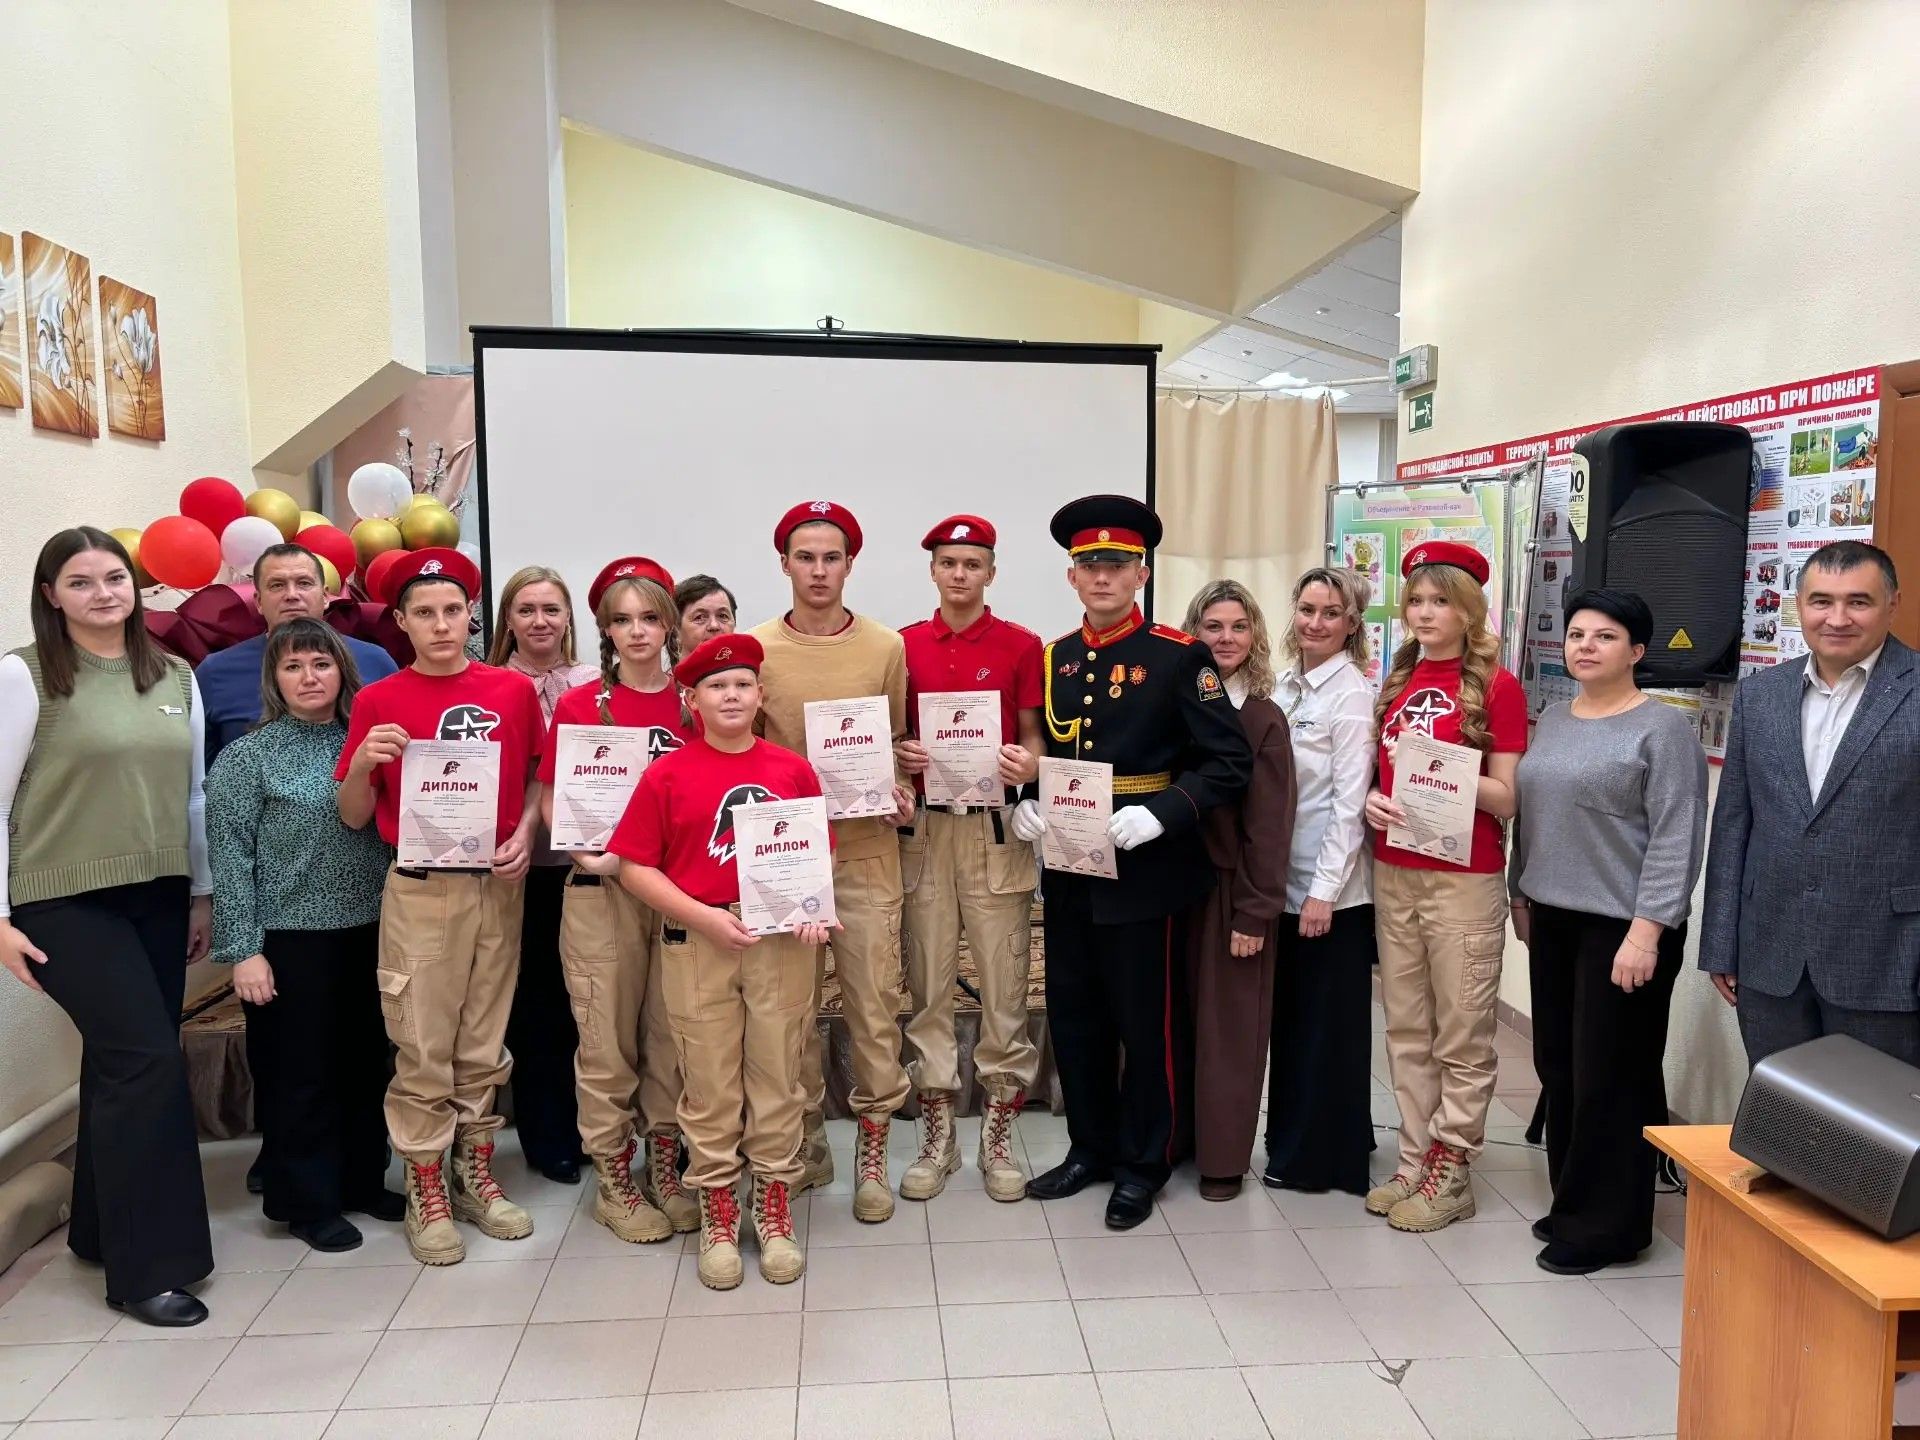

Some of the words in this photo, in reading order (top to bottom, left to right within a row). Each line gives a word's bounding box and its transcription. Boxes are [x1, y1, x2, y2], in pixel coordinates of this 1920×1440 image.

[1687, 396, 1776, 421] ДЕЙСТВОВАТЬ
[1779, 387, 1809, 410] ПРИ
[1811, 374, 1876, 404] ПОЖАРЕ
[1797, 415, 1834, 427] ПРИЧИНЫ
[1835, 407, 1872, 421] ПОЖАРОВ
[1505, 440, 1550, 461] ТЕРРОРИЗМ
[1401, 463, 1421, 479] УГОЛОК
[1422, 453, 1464, 474] ГРАЖДАНСКОЙ
[1464, 449, 1495, 467] ЗАЩИТЫ
[1569, 495, 1585, 503] ATTS
[823, 734, 874, 750] ДИПЛОМ
[935, 729, 984, 740] ДИПЛОМ
[573, 765, 628, 776] ДИПЛОМ
[421, 781, 479, 793] ДИПЛОМ
[1409, 773, 1459, 794] ДИПЛОМ
[1053, 795, 1096, 809] ДИПЛОМ
[754, 839, 810, 857] ДИПЛОМ
